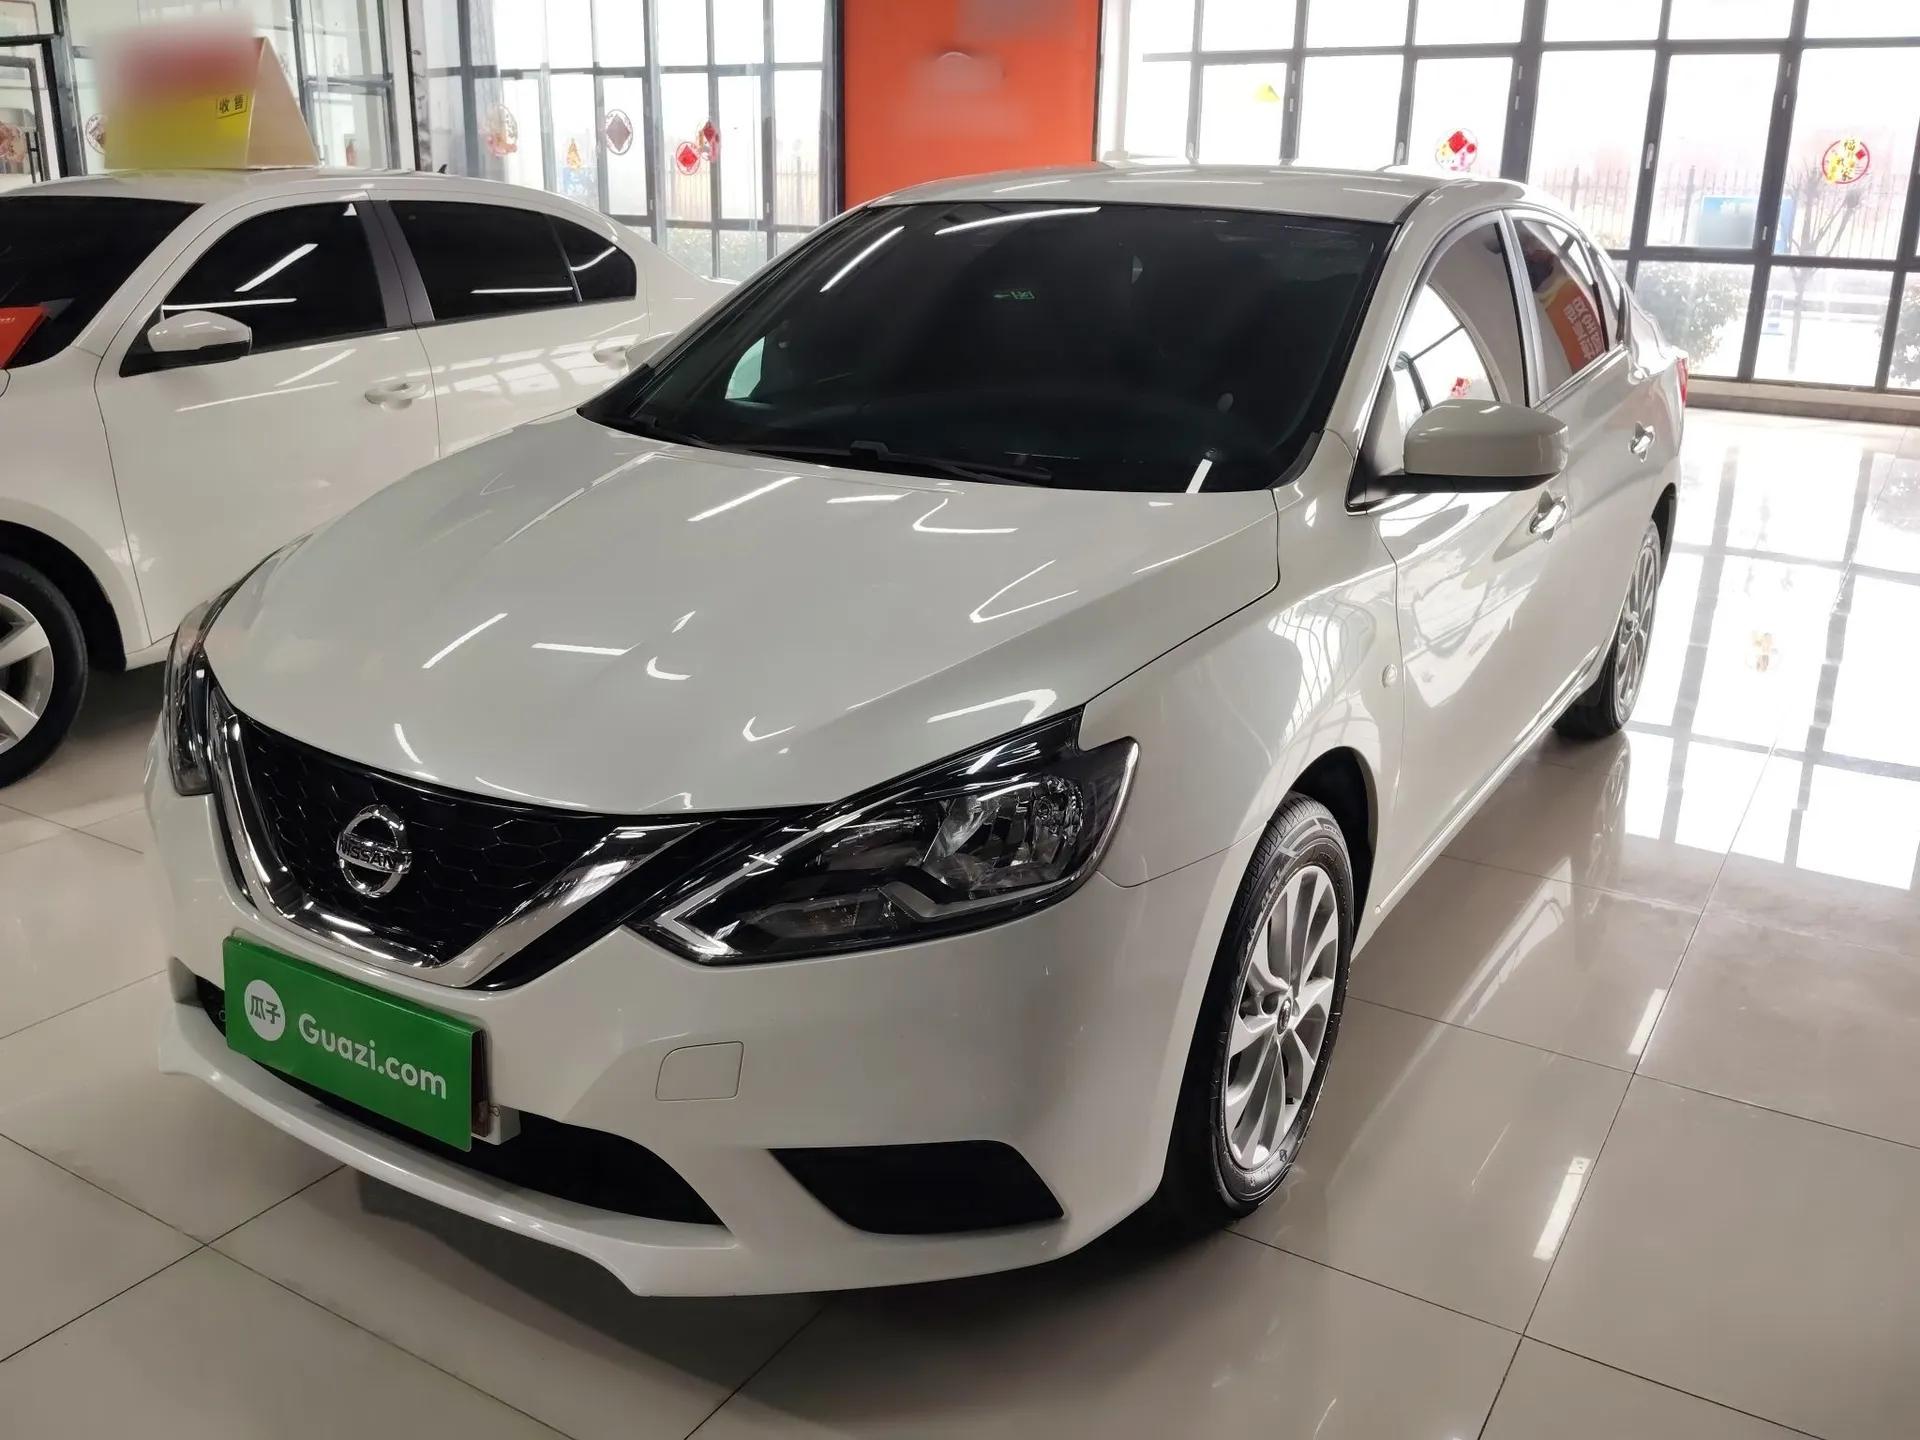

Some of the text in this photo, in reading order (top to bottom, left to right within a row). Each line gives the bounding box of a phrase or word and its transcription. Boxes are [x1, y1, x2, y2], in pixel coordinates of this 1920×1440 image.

[341, 837, 397, 869] NISSAN
[250, 995, 281, 1025] 瓜子
[299, 1013, 446, 1100] Guazi.com
